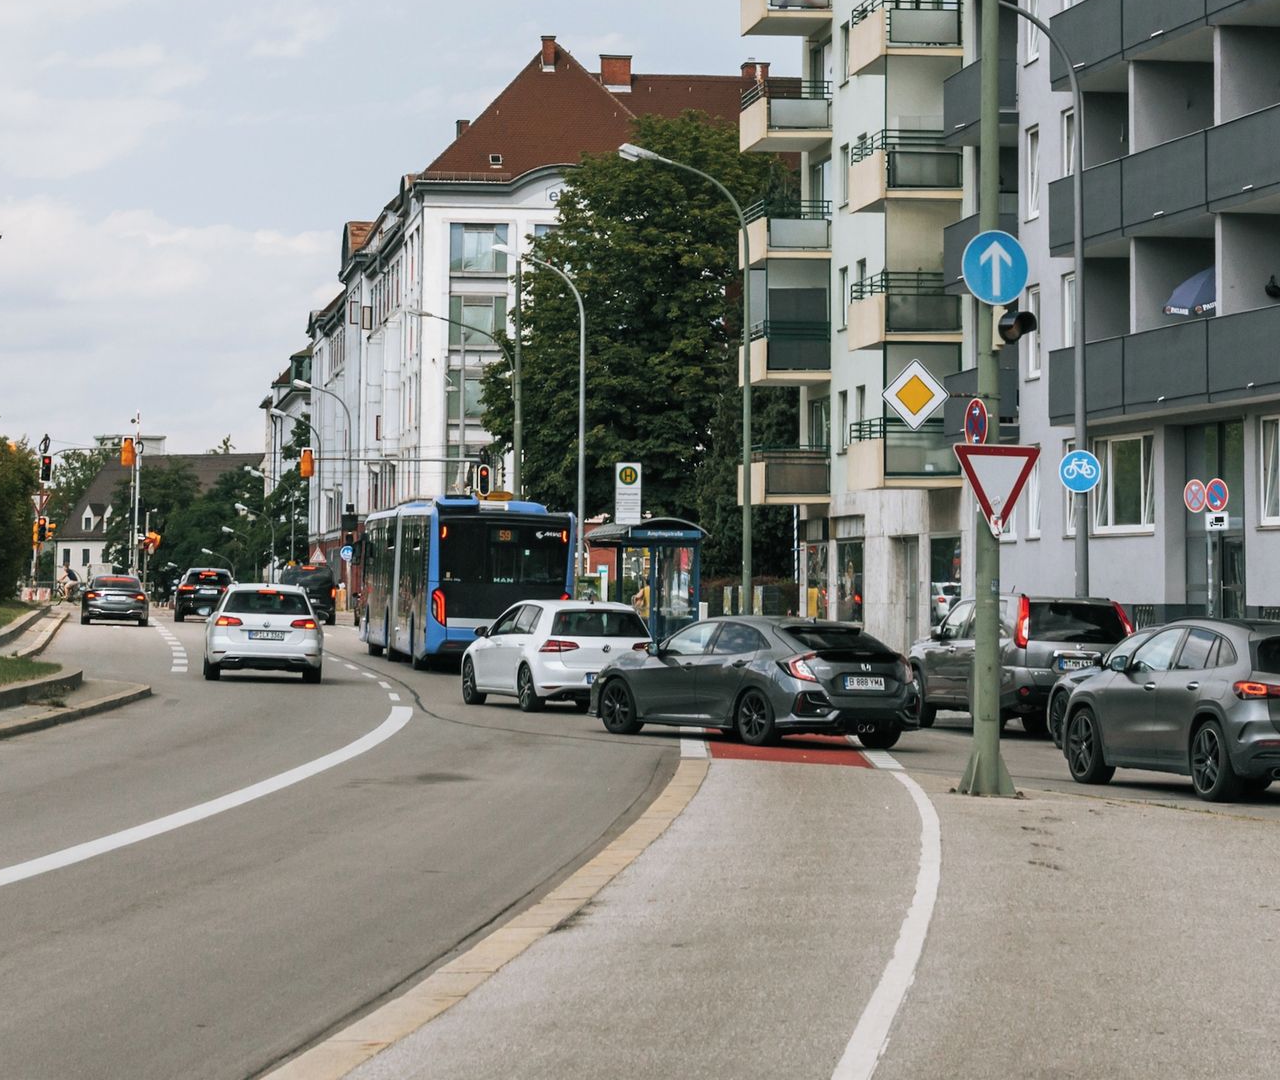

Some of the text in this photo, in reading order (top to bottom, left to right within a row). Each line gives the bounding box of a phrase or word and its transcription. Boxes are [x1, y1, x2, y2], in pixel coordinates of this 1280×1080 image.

[499, 530, 512, 541] 59
[849, 677, 854, 686] B
[870, 678, 883, 686] YMA
